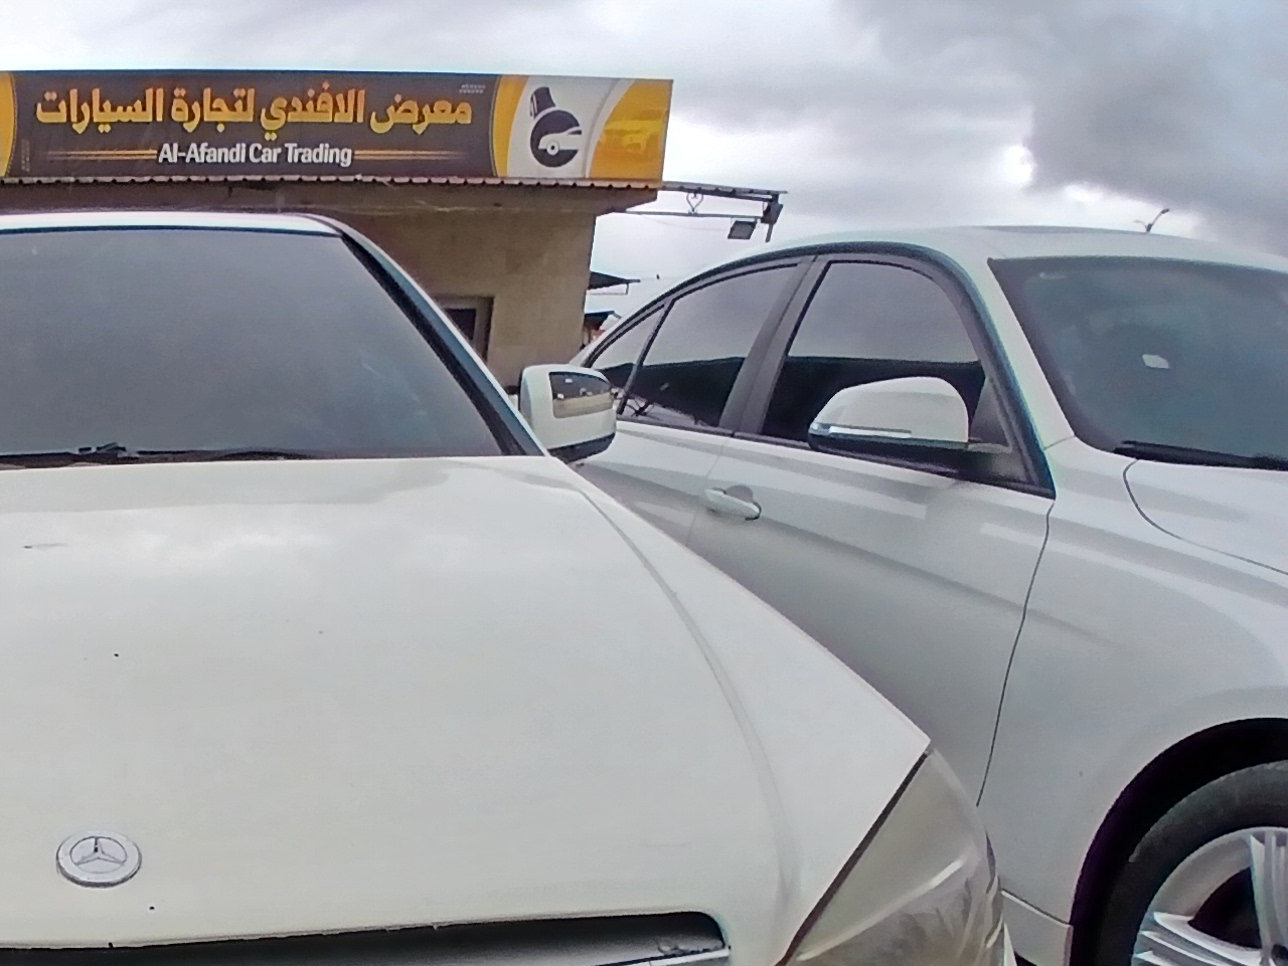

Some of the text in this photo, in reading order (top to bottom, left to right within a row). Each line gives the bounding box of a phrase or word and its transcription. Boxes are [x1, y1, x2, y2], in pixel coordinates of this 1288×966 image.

[36, 87, 164, 134] السيارات
[171, 87, 255, 133] لتجارة
[370, 93, 473, 135] معرض
[158, 142, 353, 167] Al-Afandi Car Trading
